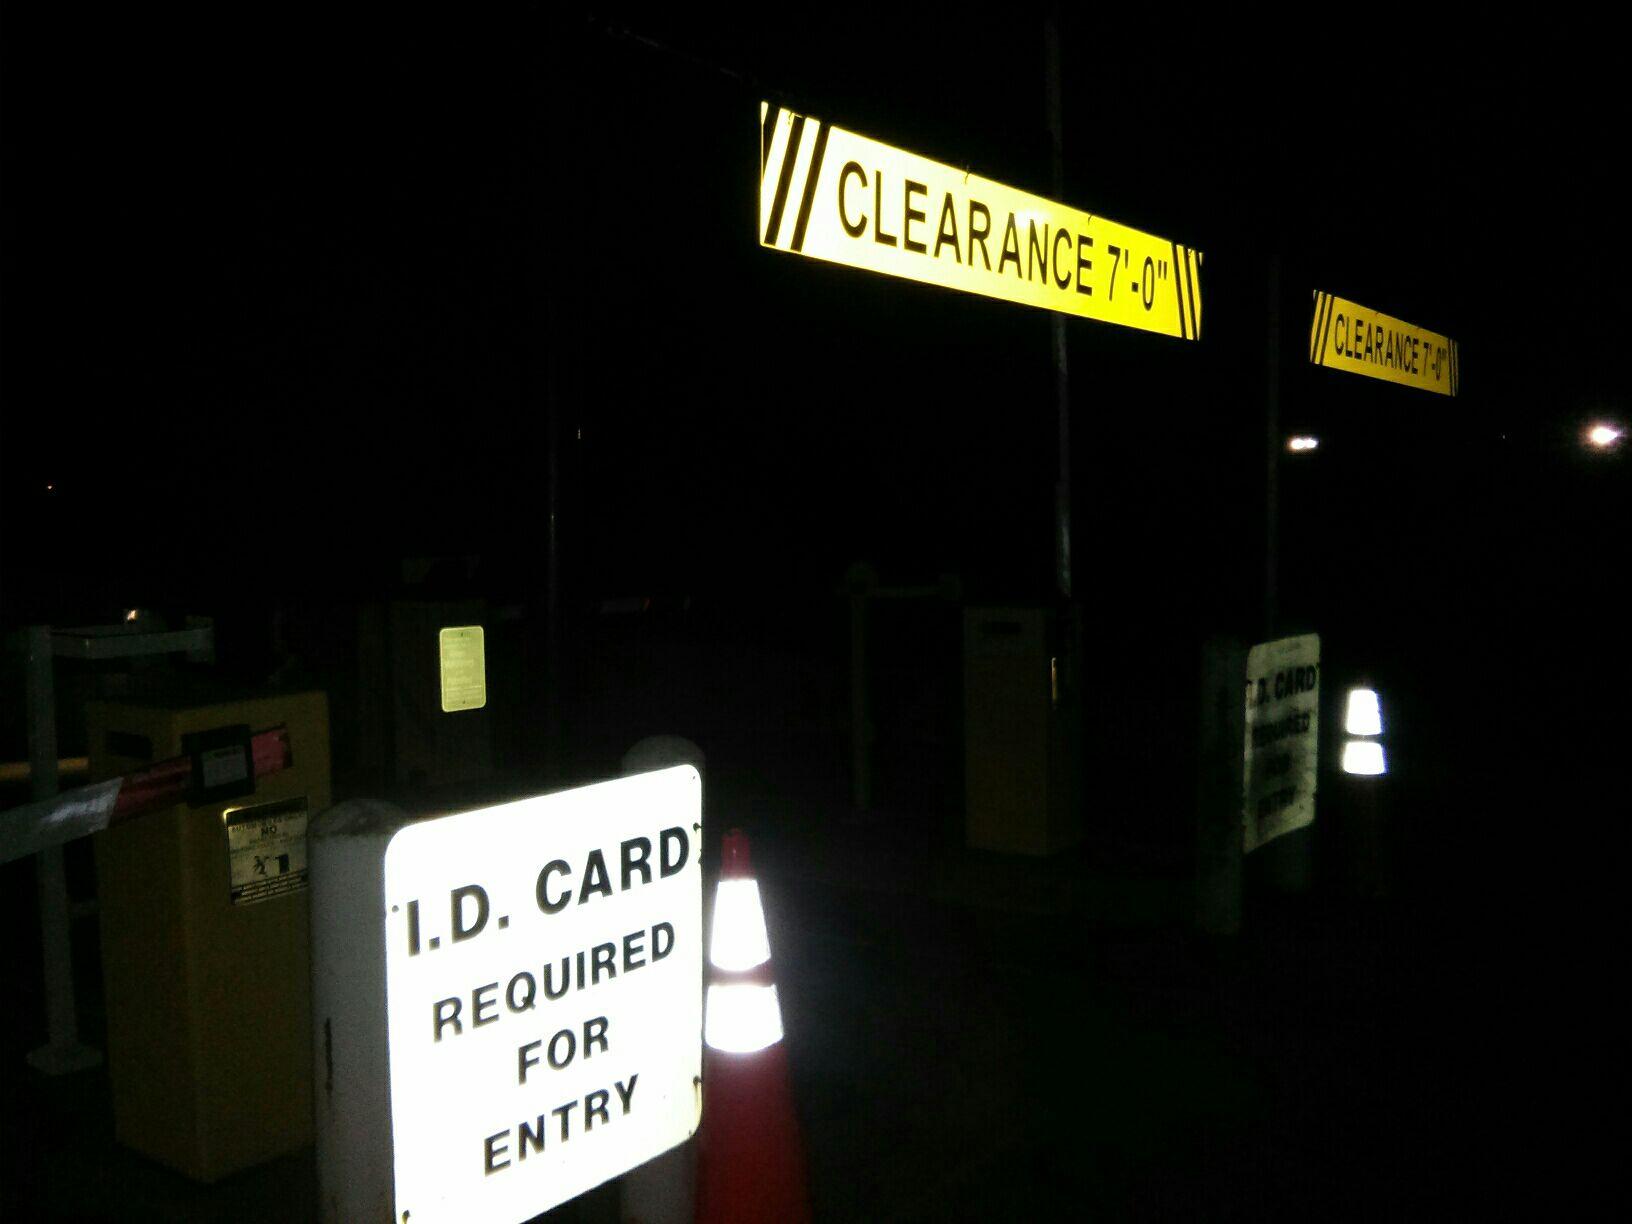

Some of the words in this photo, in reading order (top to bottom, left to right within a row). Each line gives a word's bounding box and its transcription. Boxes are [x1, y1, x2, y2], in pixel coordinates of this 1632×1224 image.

[838, 160, 1094, 296] CLEARANCE
[1334, 313, 1419, 375] CLEARANCE
[1274, 665, 1316, 700] CARD
[406, 884, 510, 957] I.D.
[535, 826, 690, 914] CARD
[432, 921, 676, 1043] REQUIRED
[517, 1015, 610, 1086] FOR
[483, 1074, 639, 1178] ENTRY
